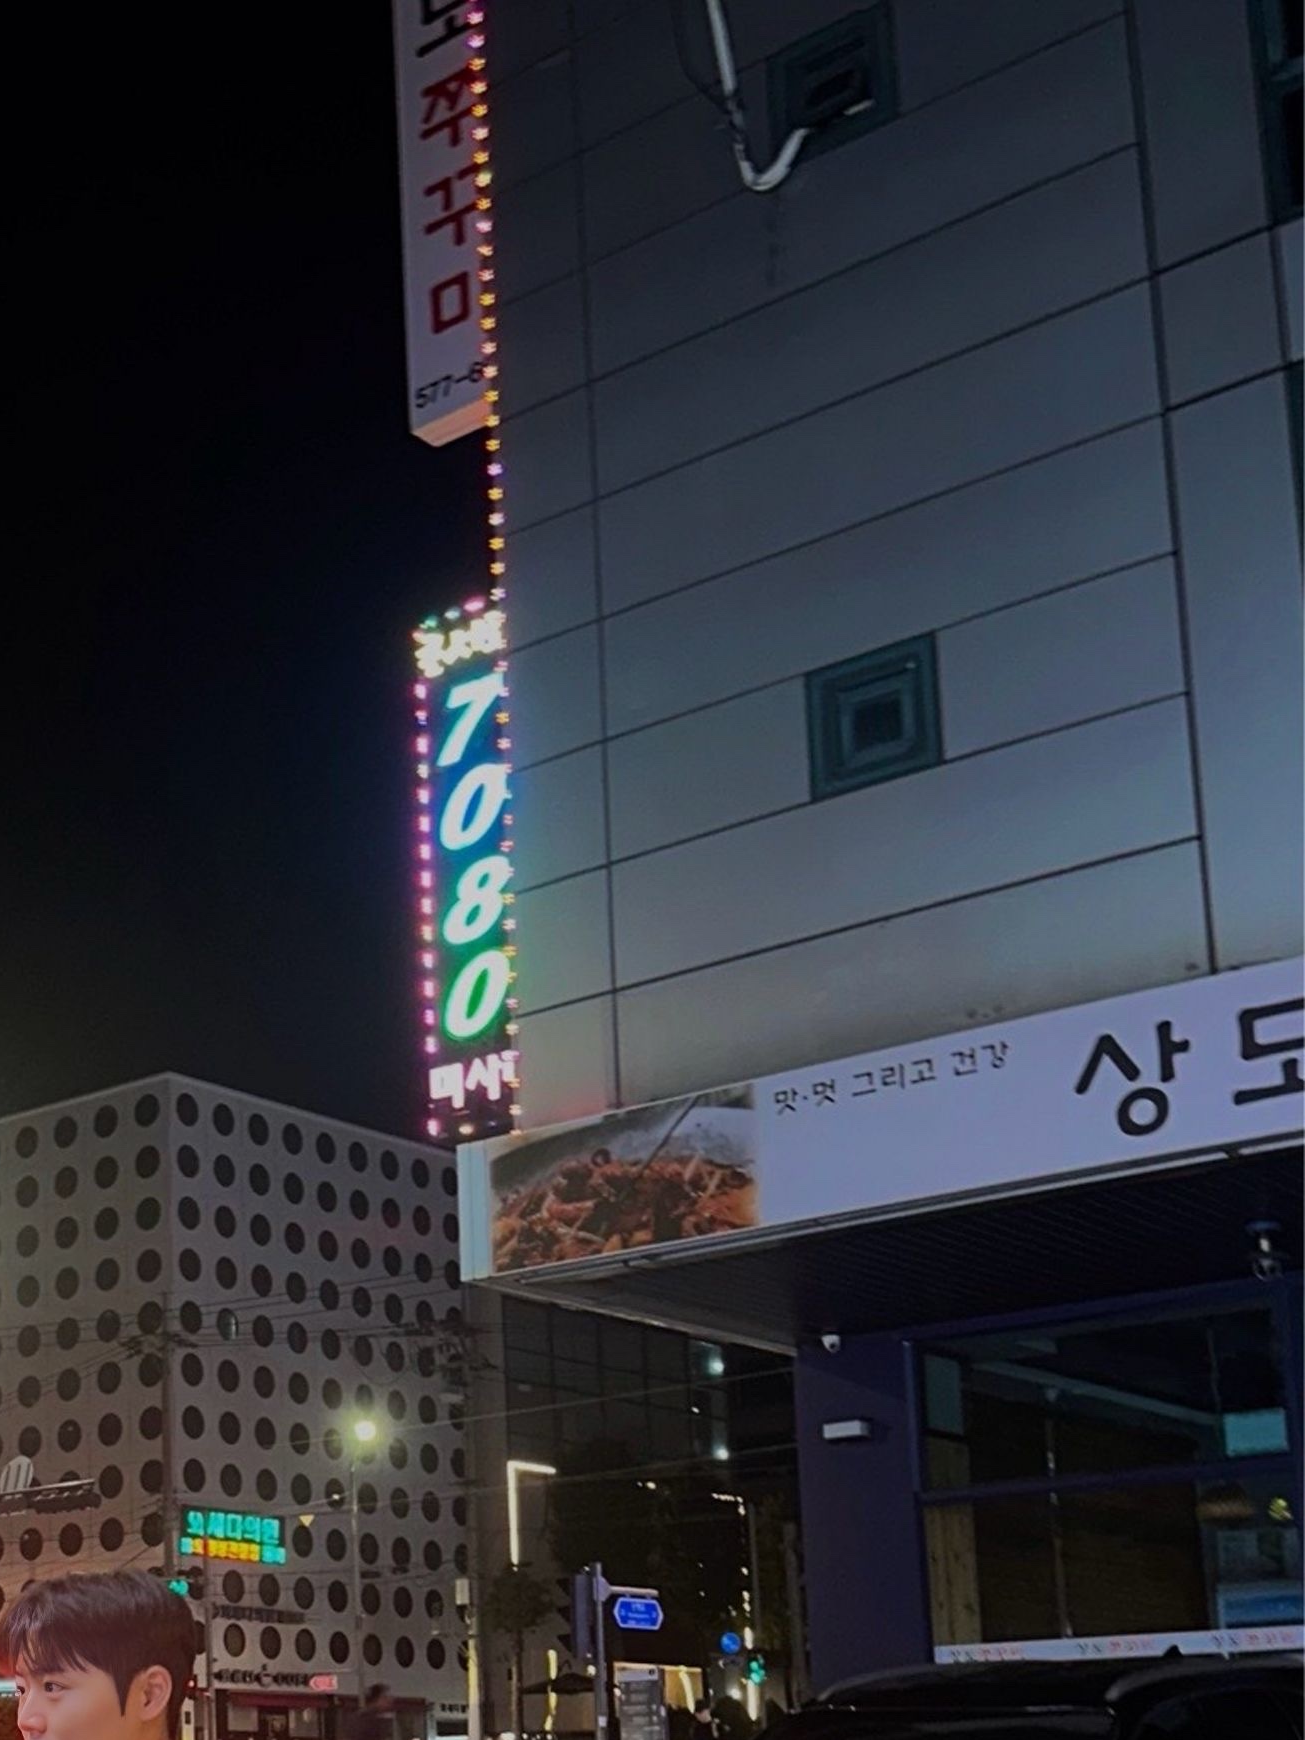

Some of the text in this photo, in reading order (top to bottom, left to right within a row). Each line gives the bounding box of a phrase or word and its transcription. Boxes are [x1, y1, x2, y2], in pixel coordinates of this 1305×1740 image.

[436, 672, 511, 1038] 7080
[852, 1057, 937, 1097] 그리고
[951, 1041, 1009, 1077] 건강
